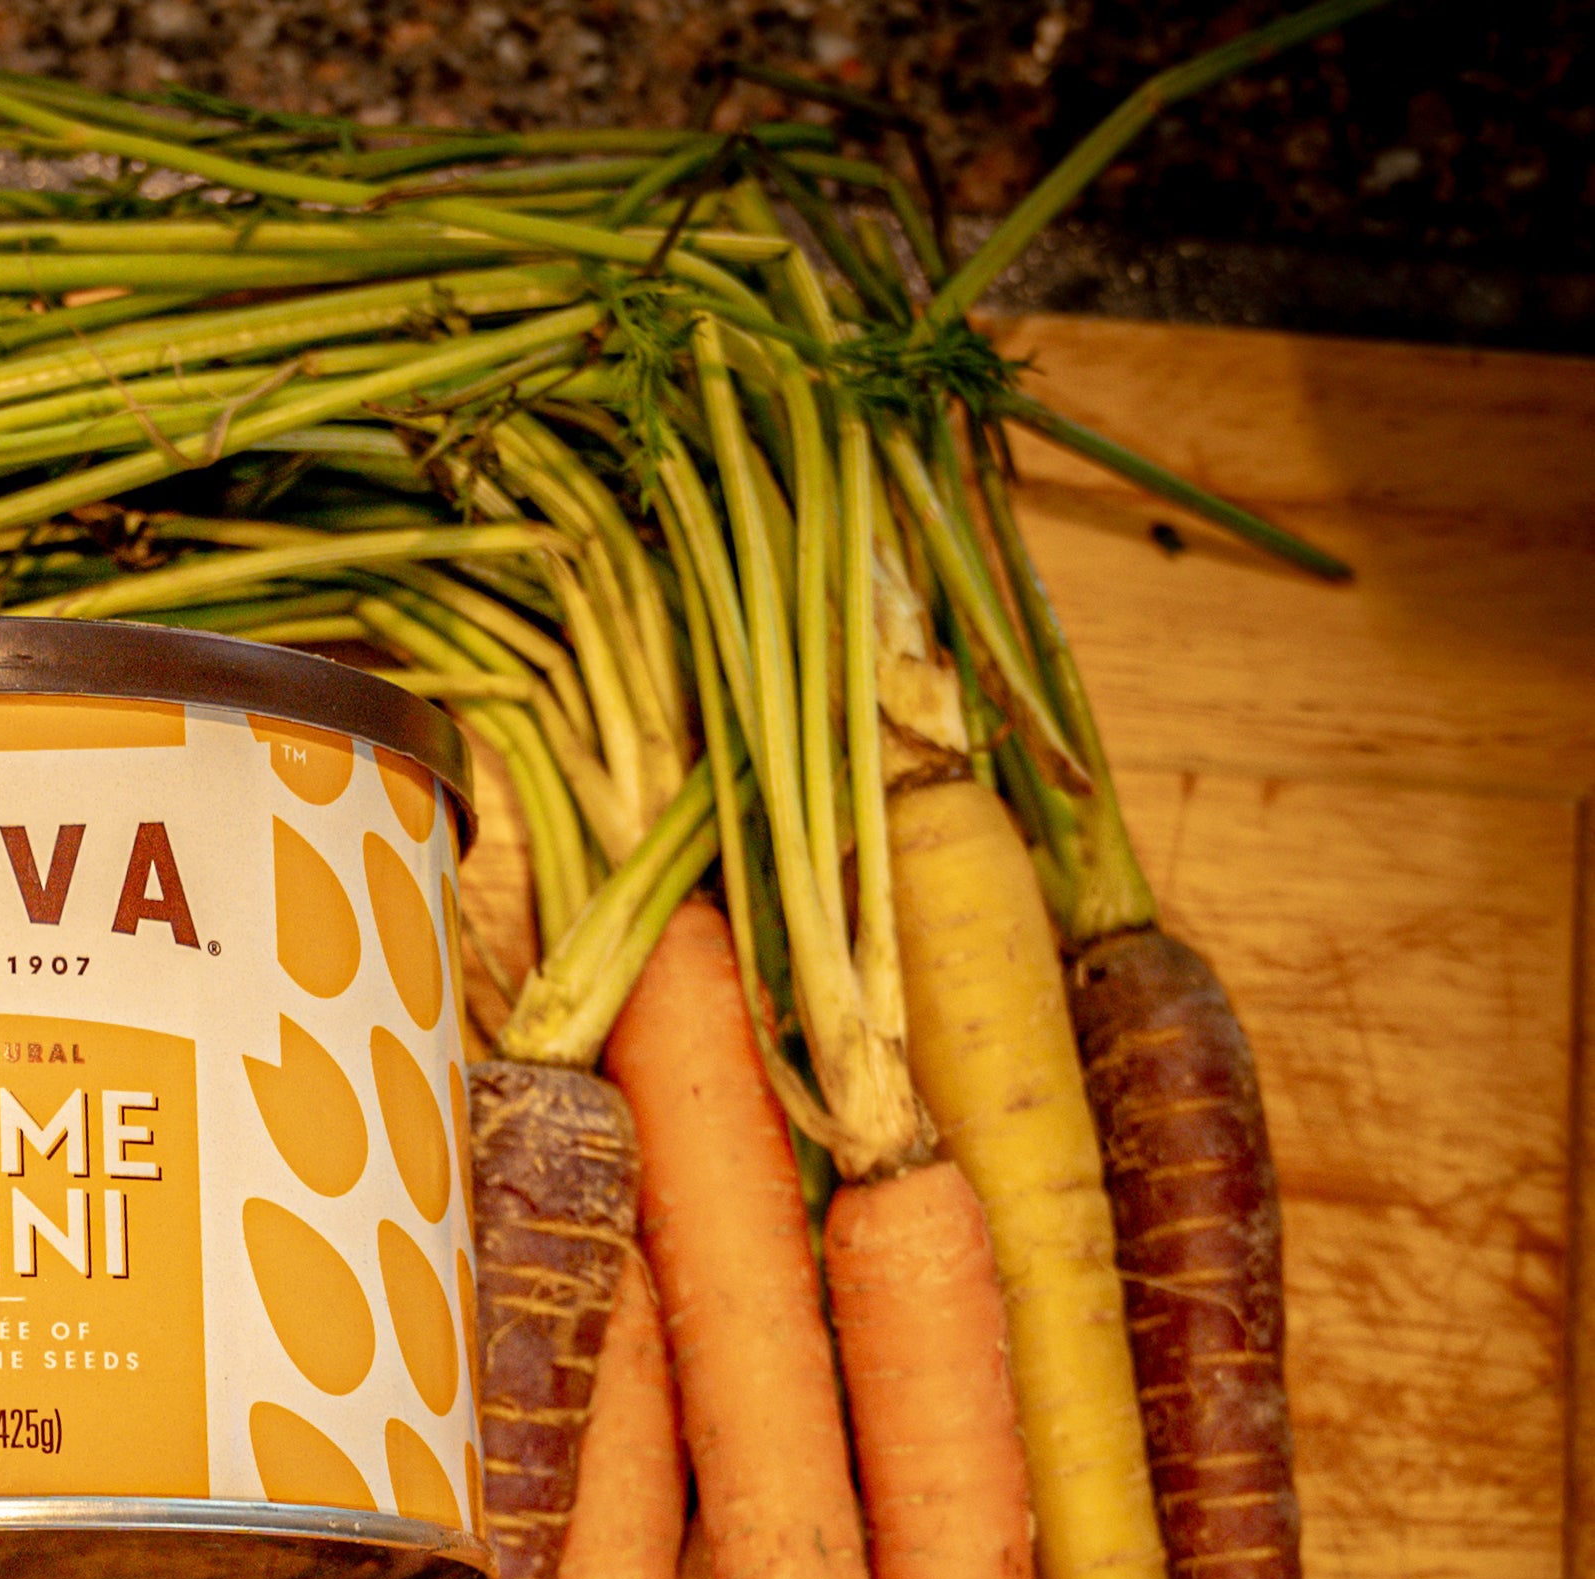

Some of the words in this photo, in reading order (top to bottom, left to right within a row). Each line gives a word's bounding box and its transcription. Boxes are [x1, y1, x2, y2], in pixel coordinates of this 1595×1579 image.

[7, 956, 91, 976] 1907
[51, 1322, 92, 1341] OF
[44, 1350, 141, 1371] SEEDS
